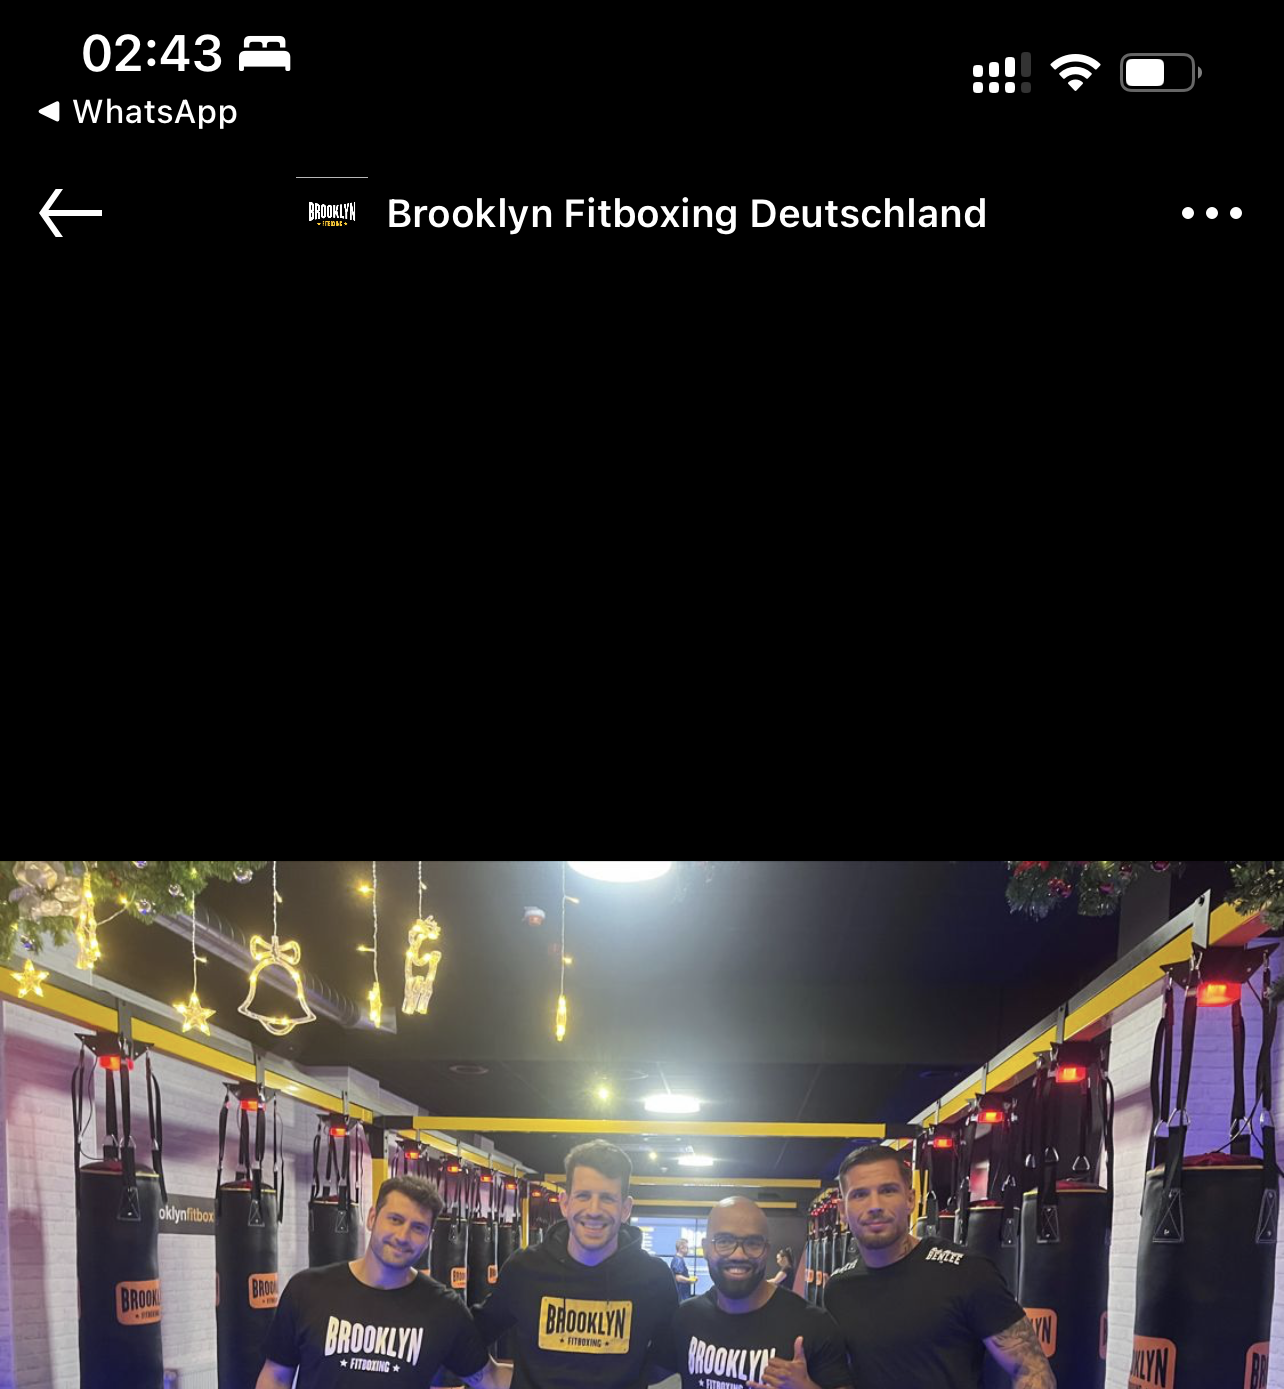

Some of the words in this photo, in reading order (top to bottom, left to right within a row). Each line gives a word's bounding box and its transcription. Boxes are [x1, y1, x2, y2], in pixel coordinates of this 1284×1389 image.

[546, 1303, 626, 1339] BROOKLYN
[324, 1315, 424, 1367] BROOKLYN
[567, 1337, 602, 1348] FITBOXING
[349, 1358, 390, 1373] FITBOXING
